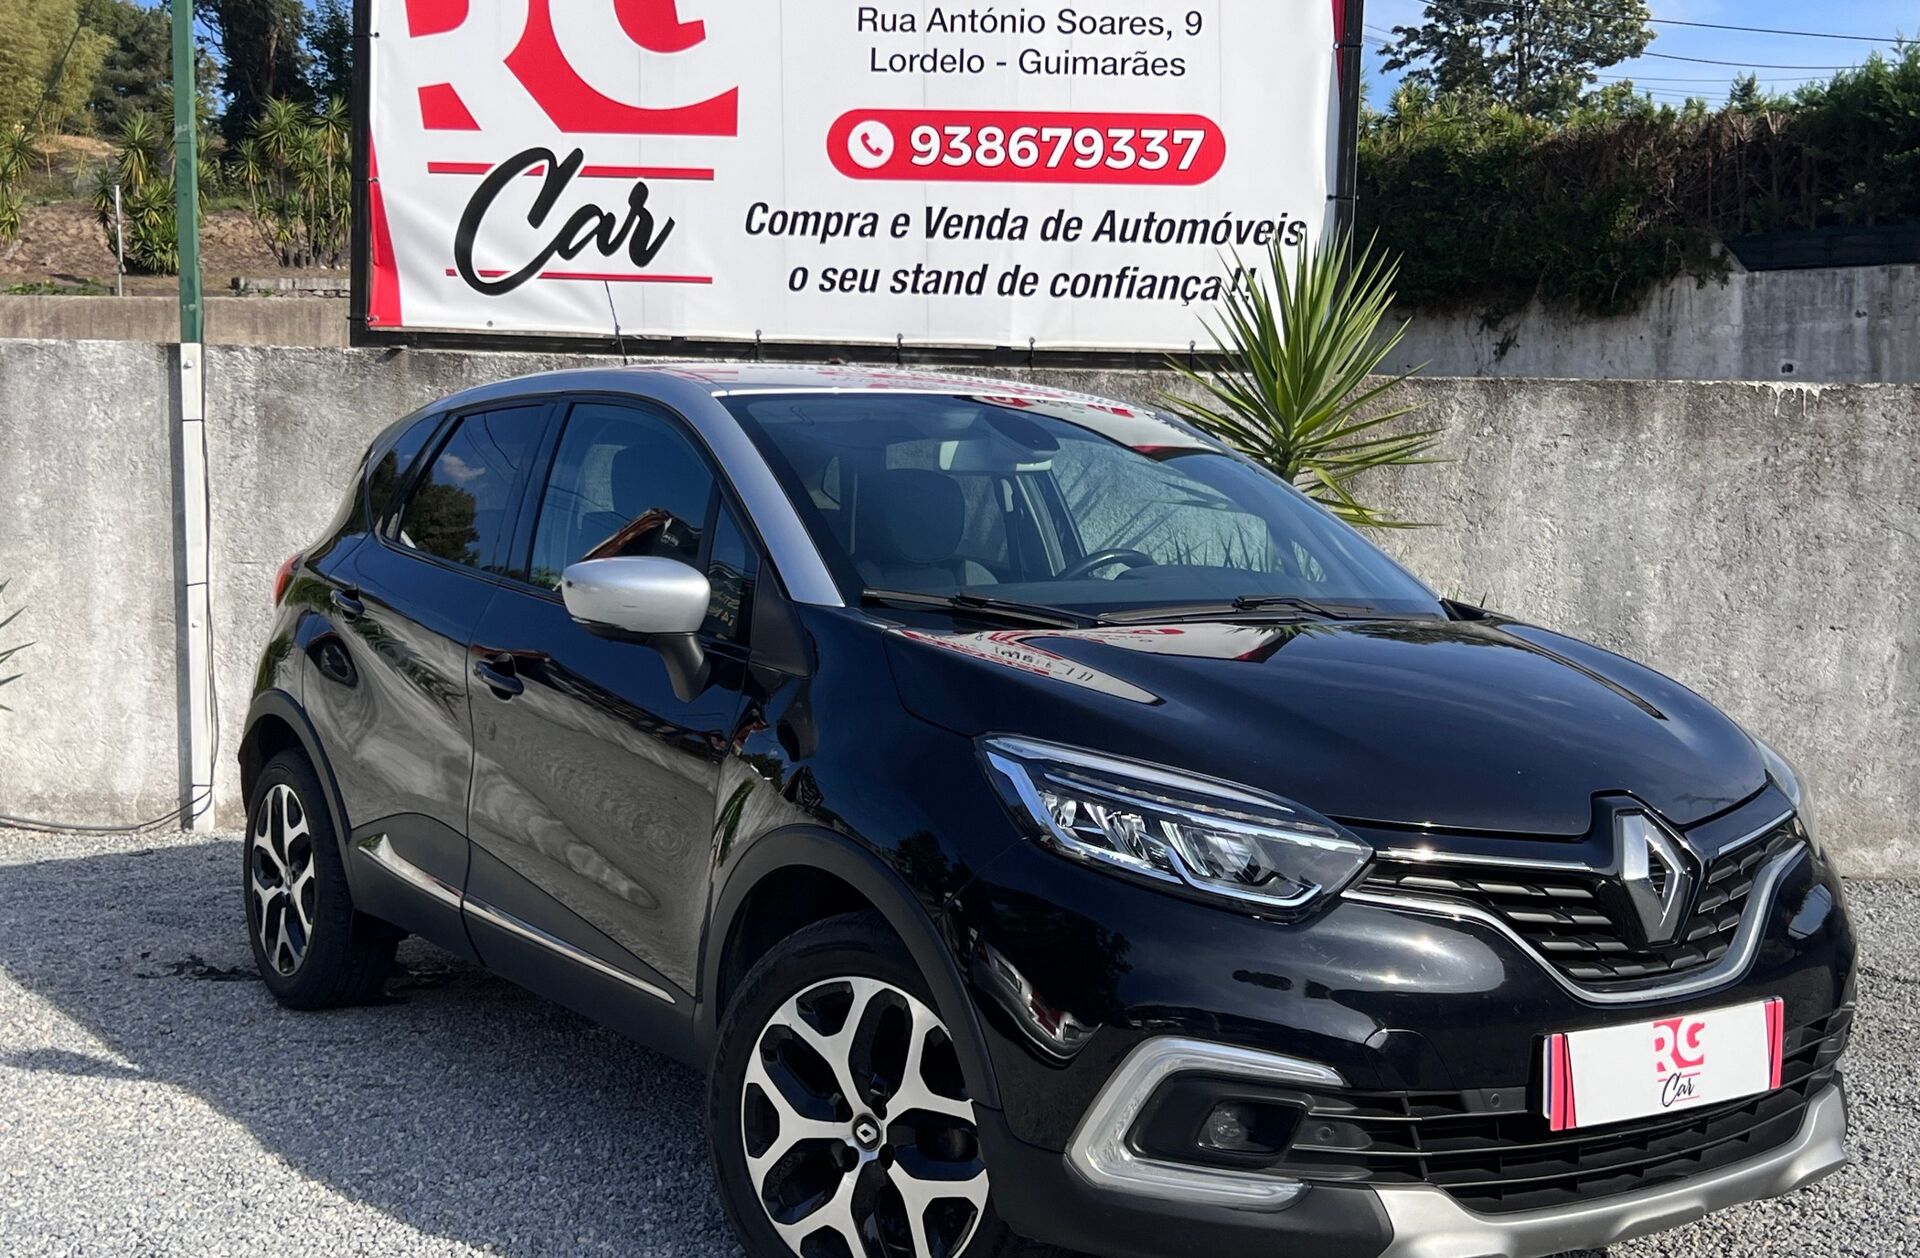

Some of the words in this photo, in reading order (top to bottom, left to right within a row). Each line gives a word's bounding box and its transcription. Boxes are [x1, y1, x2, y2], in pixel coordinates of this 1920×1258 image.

[857, 6, 917, 33] Rua
[926, 7, 1046, 34] António
[1056, 8, 1172, 41] Soares,
[1185, 10, 1203, 36] 9
[870, 47, 985, 74] Lordelo
[1018, 48, 1186, 77] Guimarães
[910, 125, 1206, 171] 938679337
[454, 147, 675, 296] Car
[745, 201, 879, 245] Compra
[890, 213, 911, 239] e
[925, 206, 1029, 241] Venda
[1040, 208, 1083, 242] de
[1091, 209, 1307, 247] Automóveis
[788, 266, 809, 292] o
[818, 267, 881, 293] seu
[889, 263, 989, 296] stand
[997, 264, 1039, 297] de
[1049, 266, 1222, 307] confiança
[1652, 1017, 1706, 1073] RG
[1661, 1072, 1695, 1108] Car
